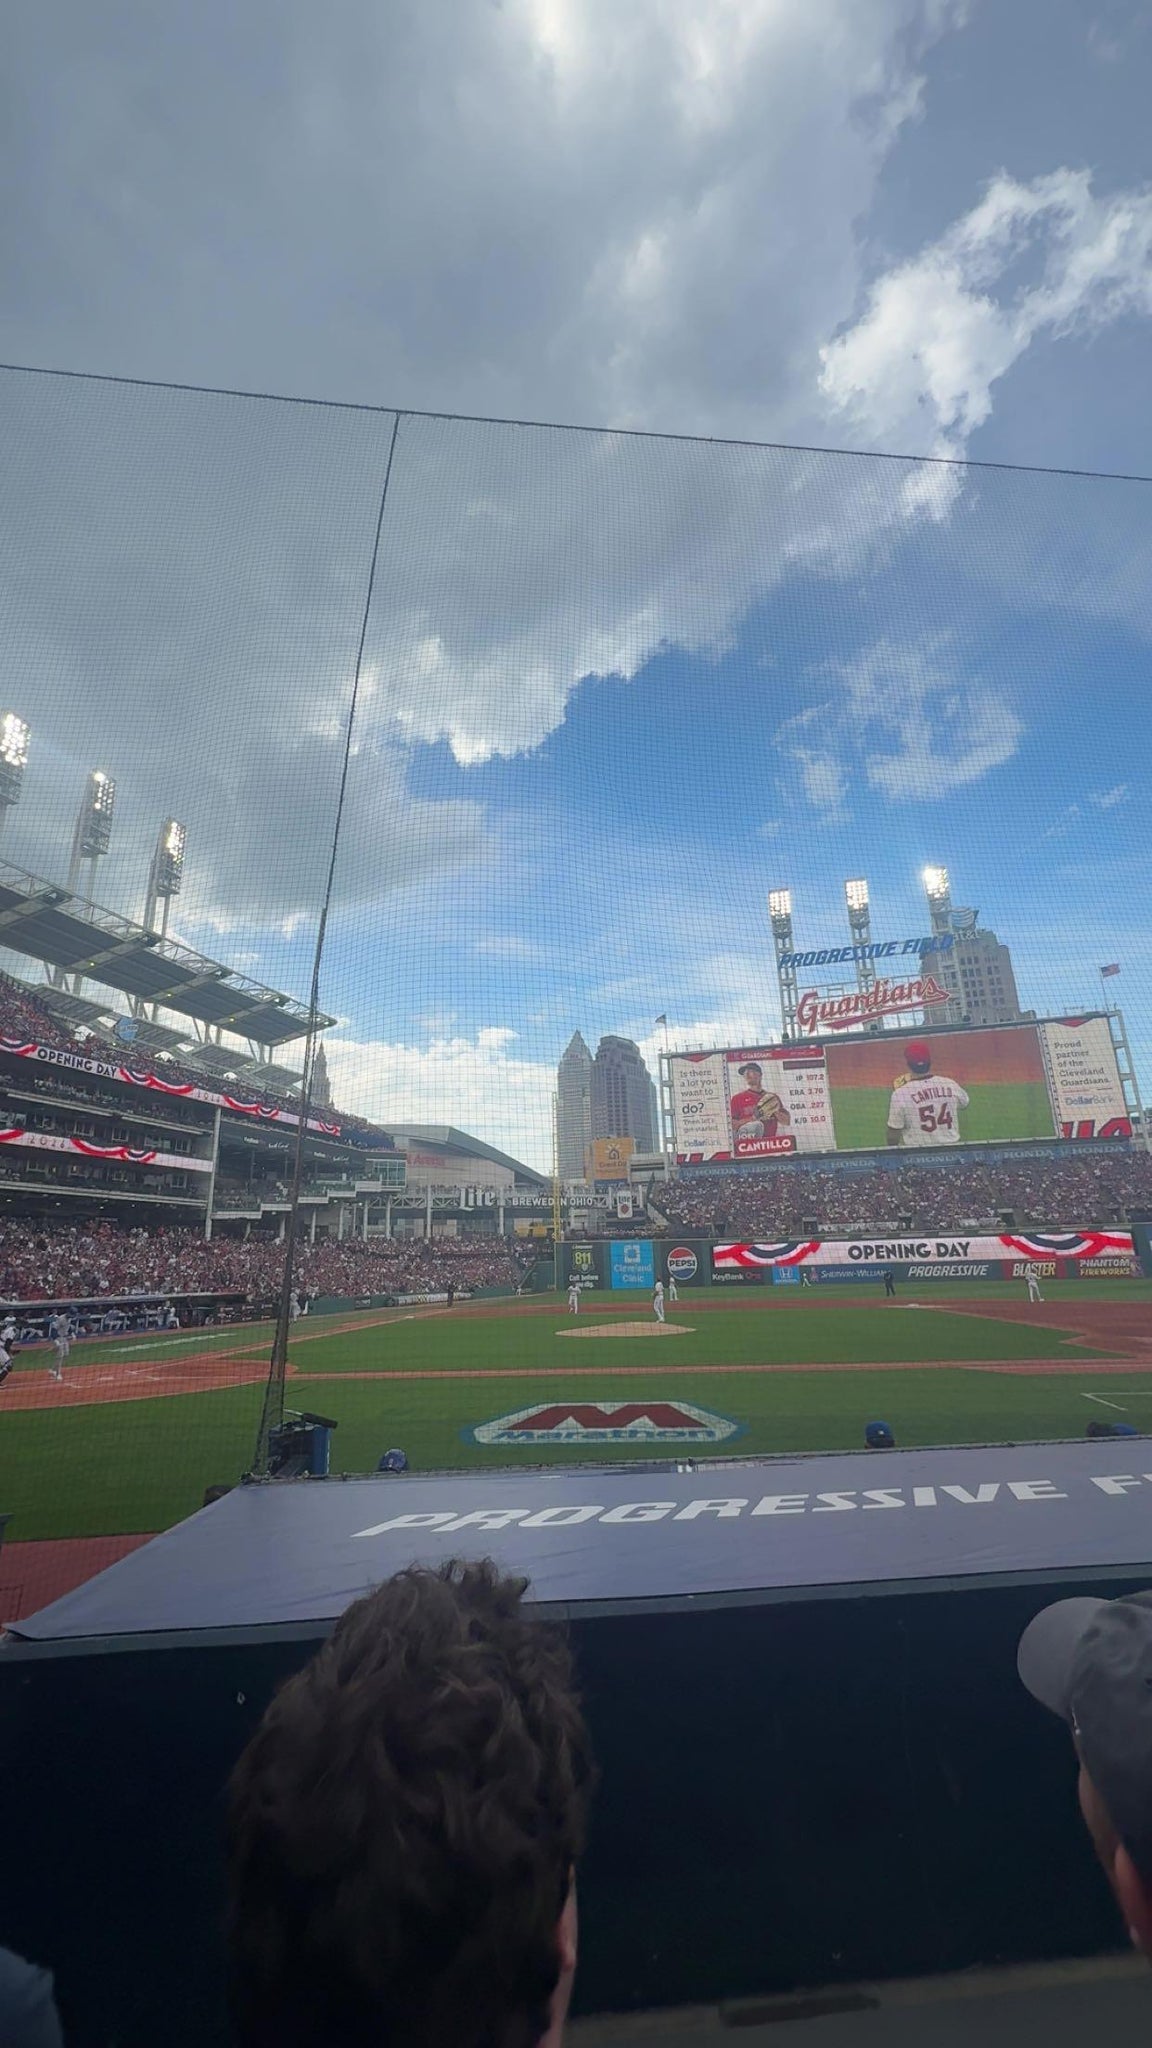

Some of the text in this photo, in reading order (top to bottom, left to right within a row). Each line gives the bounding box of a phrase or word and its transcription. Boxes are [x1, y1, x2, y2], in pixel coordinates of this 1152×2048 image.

[779, 934, 954, 968] PROGRESSIVE FIELD
[796, 975, 950, 1033] Guardians
[1054, 1040, 1082, 1049] Proud
[37, 1048, 117, 1077] OPENING DAY
[1059, 1067, 1105, 1077] Cleveland
[911, 1087, 953, 1104] CANTILLO
[682, 1102, 704, 1114] do?
[919, 1102, 953, 1133] 54
[738, 1139, 791, 1152] CANTILLO
[829, 1159, 877, 1168] HONDA
[1003, 1149, 1054, 1159] HONDA
[1071, 1145, 1126, 1154] HONDA
[459, 1187, 496, 1211] Lite
[512, 1196, 555, 1206] BREWED
[569, 1196, 593, 1206] OHIO
[847, 1241, 971, 1260] OPENING DAY
[575, 1252, 592, 1265] 811
[1079, 1258, 1131, 1268] PHANTOM
[614, 1264, 652, 1272] Cleveland
[908, 1264, 989, 1277] PROGRESSIVE
[1012, 1261, 1057, 1277] BLASTER
[1080, 1267, 1131, 1276] FIREWORKS
[622, 1274, 644, 1282] Clinic
[712, 1273, 744, 1281] KeyBank
[492, 1428, 716, 1441] Marathon
[349, 1473, 1152, 1539] PROGRESSIVE F
